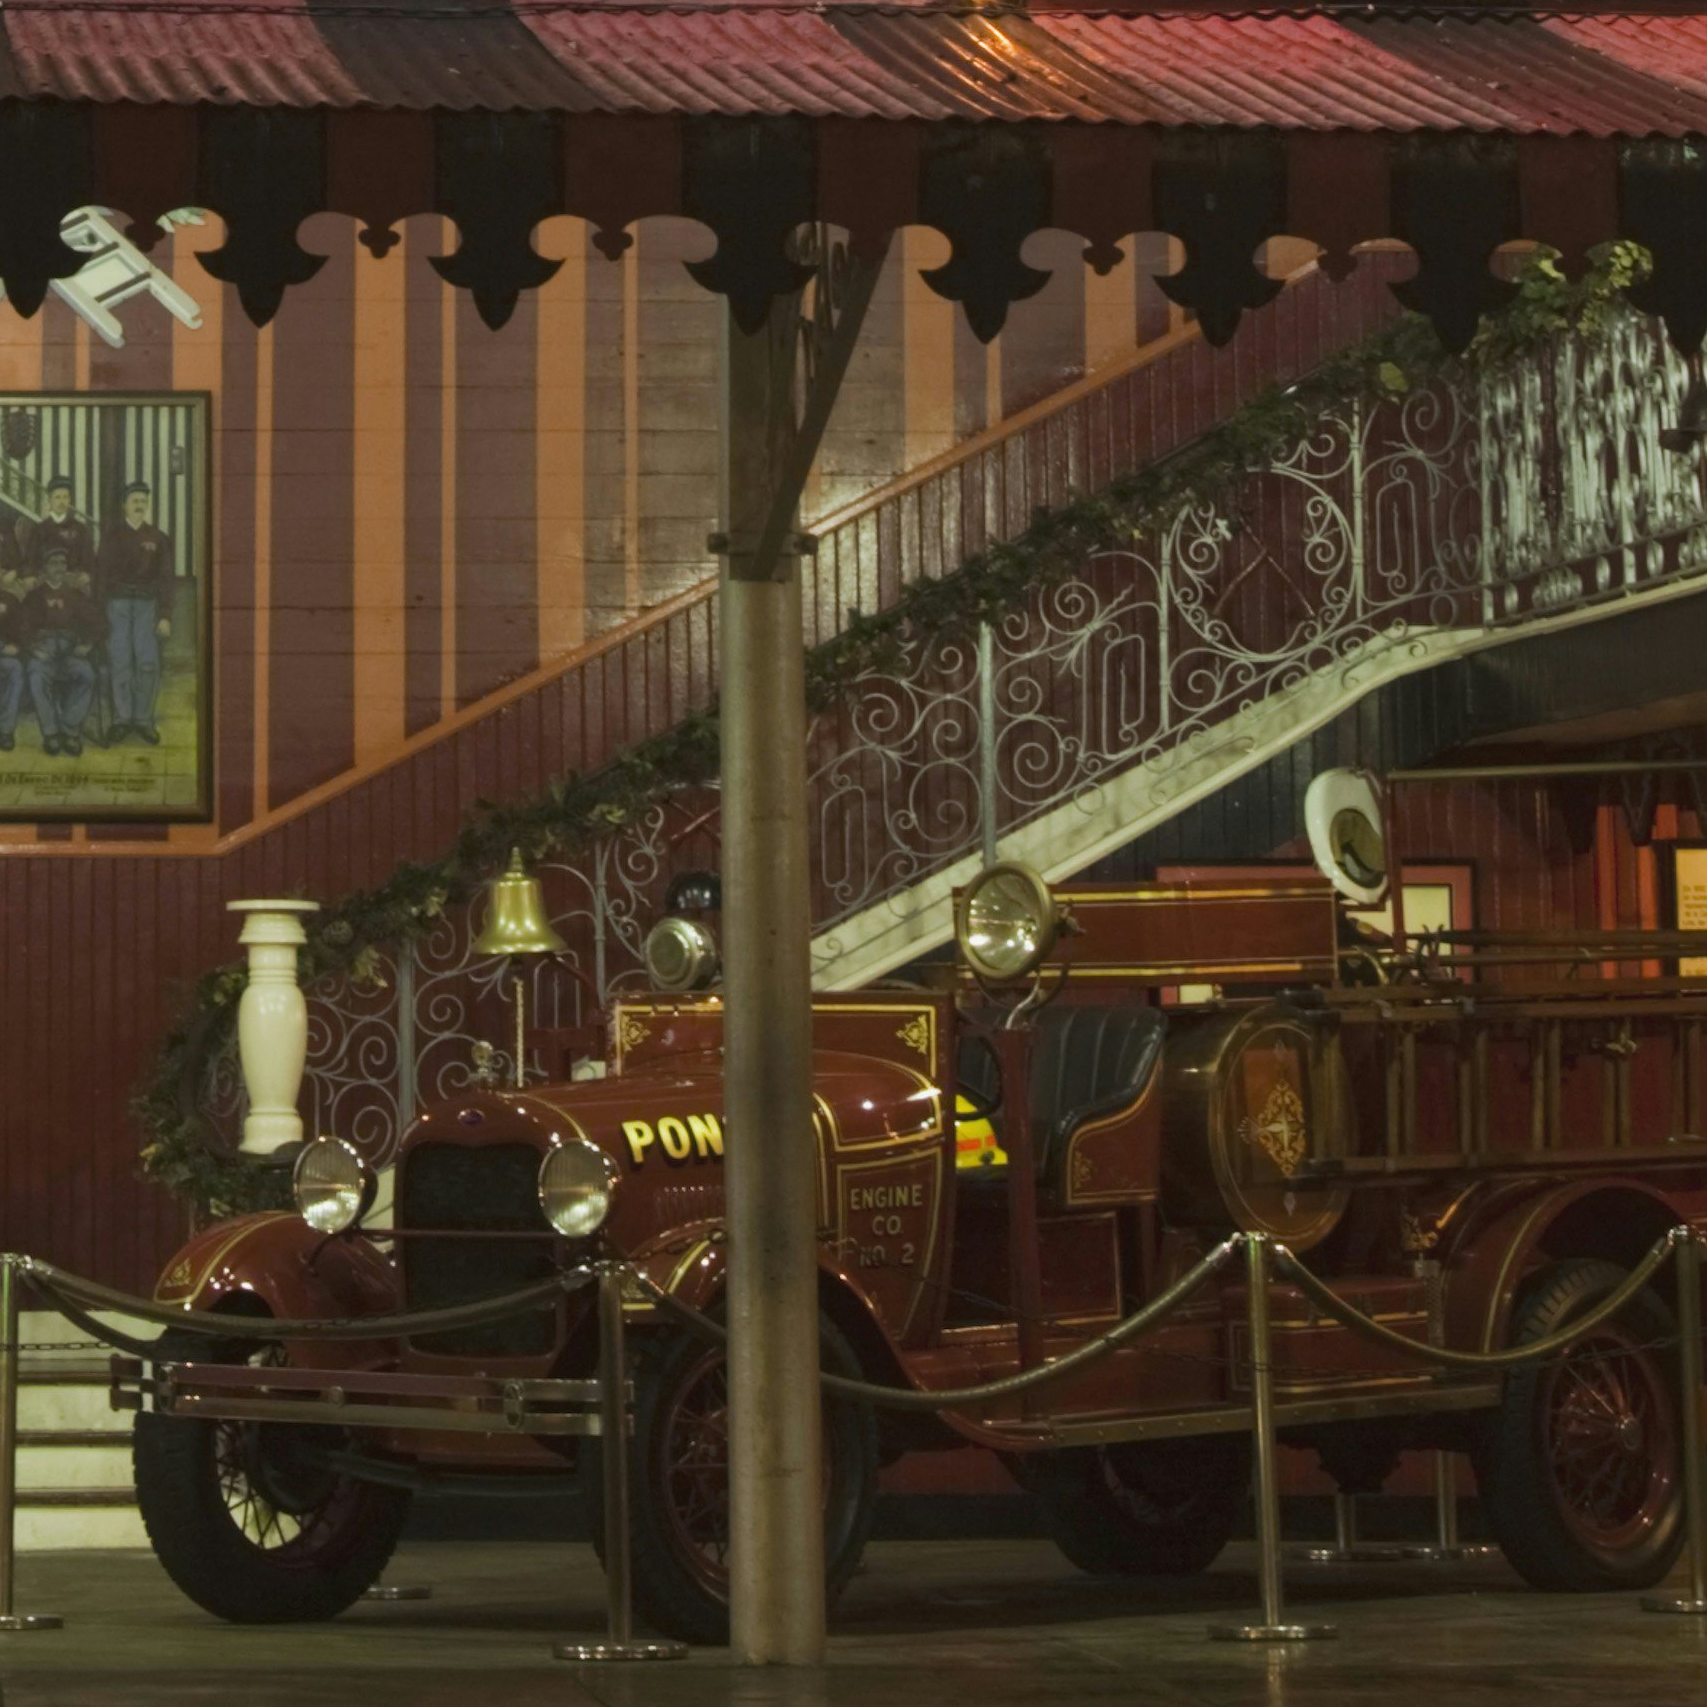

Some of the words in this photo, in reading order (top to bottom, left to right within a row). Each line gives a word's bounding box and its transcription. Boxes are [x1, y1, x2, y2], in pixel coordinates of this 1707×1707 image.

[622, 1113, 725, 1163] PON
[850, 1184, 923, 1210] ENGINE
[900, 1242, 916, 1264] 2
